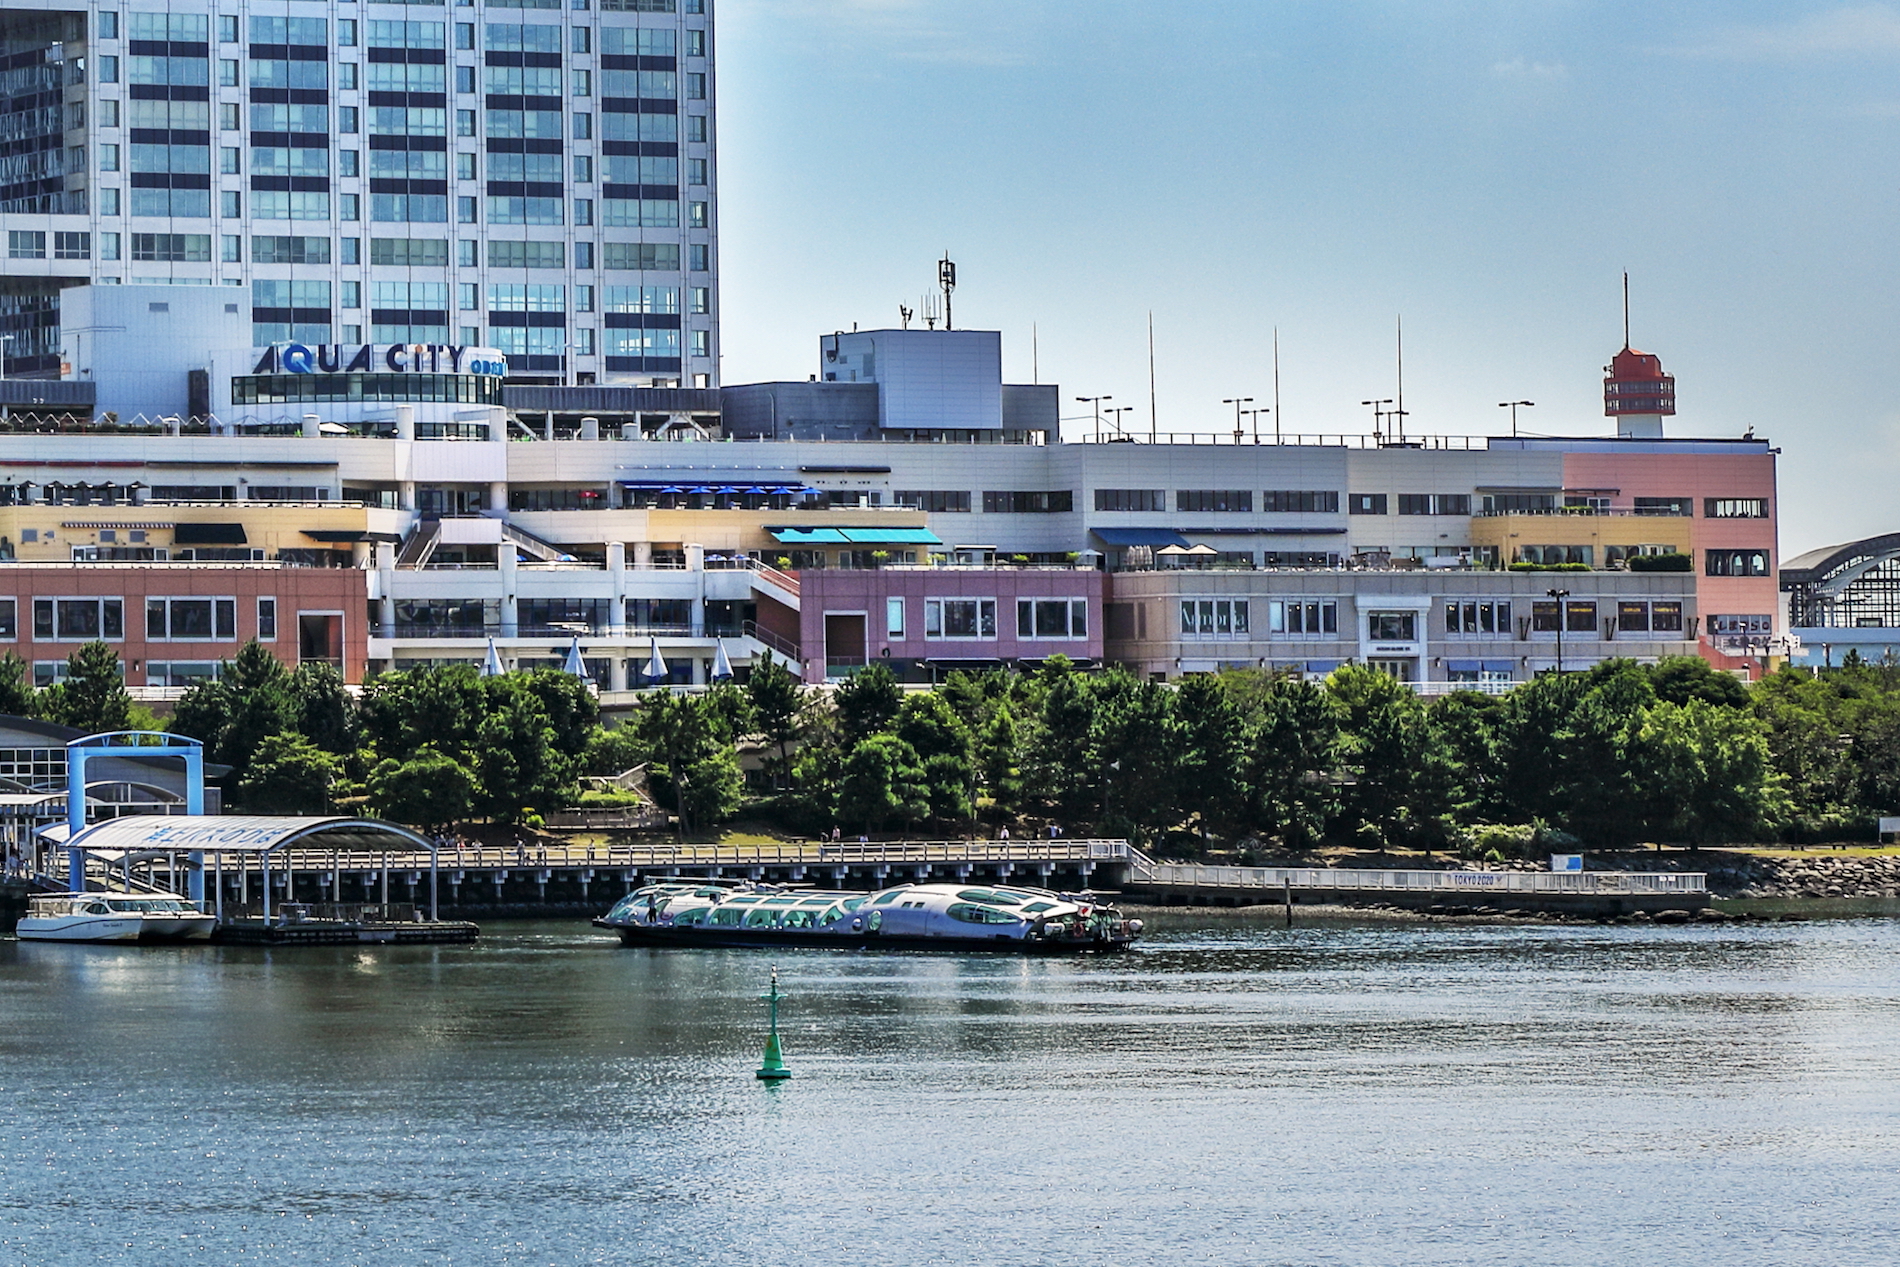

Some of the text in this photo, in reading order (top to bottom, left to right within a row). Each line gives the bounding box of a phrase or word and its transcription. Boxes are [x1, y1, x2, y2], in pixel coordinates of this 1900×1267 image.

[252, 343, 375, 374] AQUA
[1455, 875, 1494, 885] TOKYO 2020
